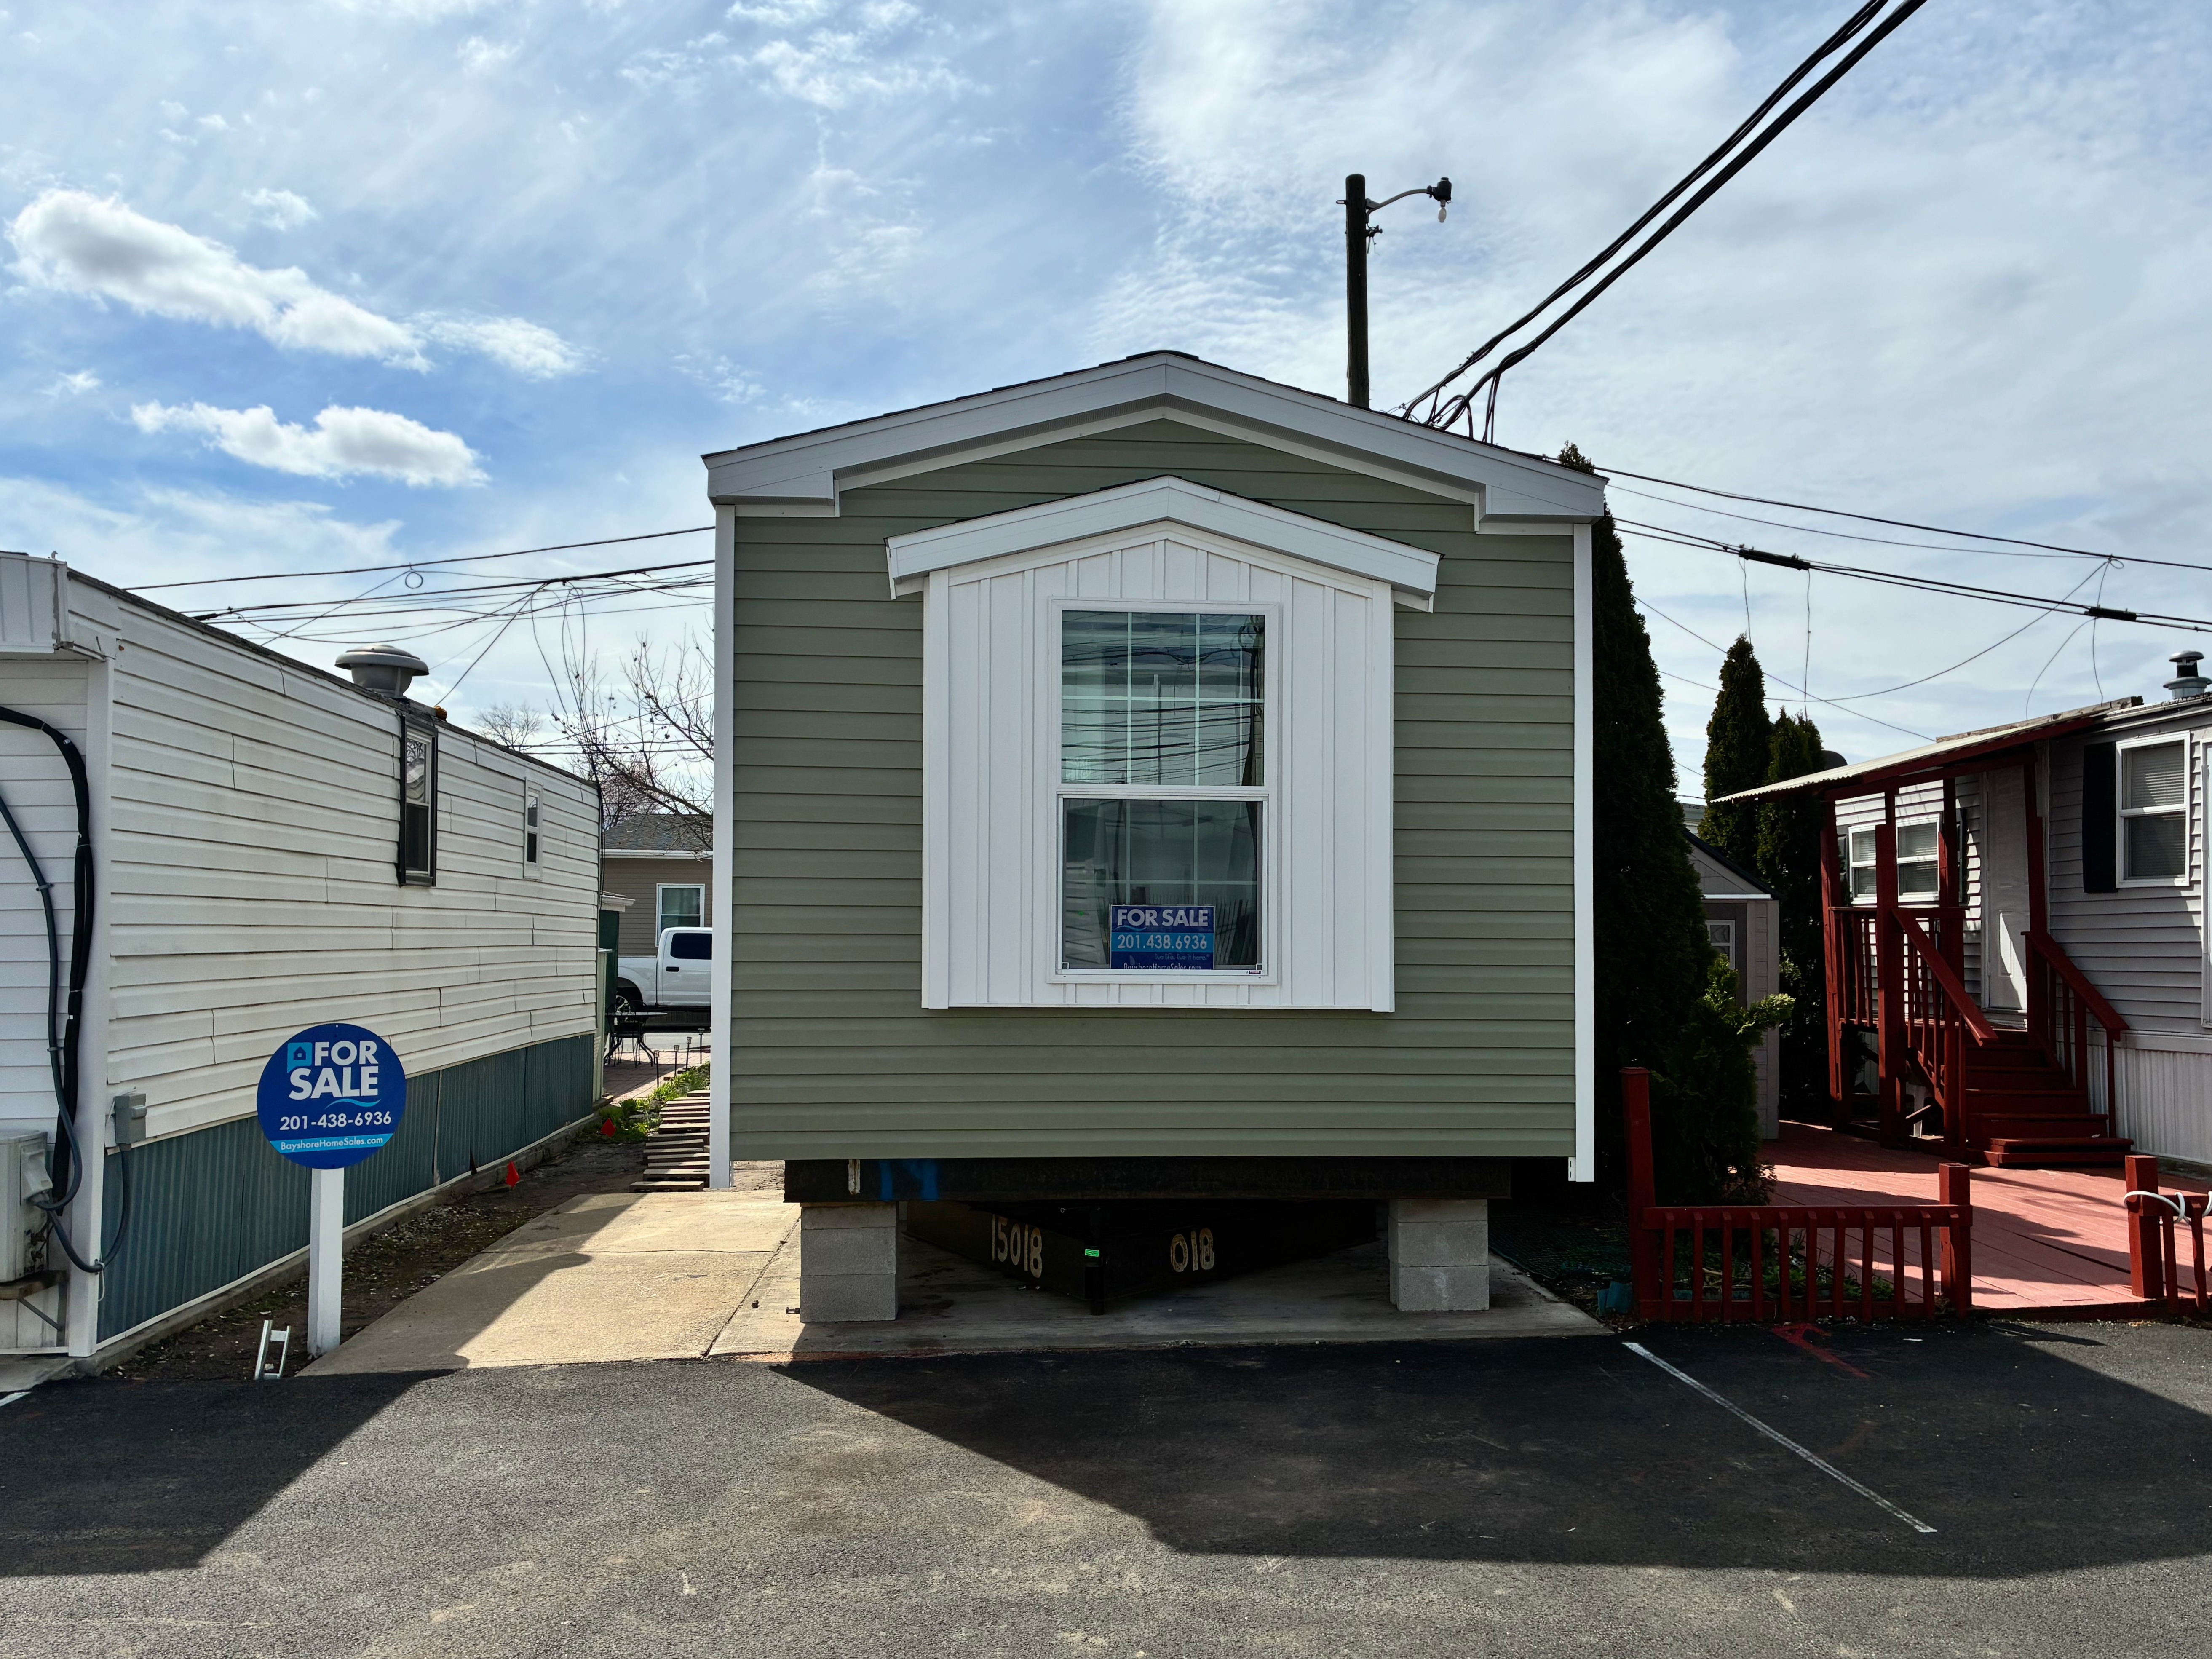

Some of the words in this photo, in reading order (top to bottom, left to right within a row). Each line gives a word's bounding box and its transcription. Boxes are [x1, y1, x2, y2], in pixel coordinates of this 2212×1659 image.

[1117, 908, 1158, 926] FOR
[1162, 909, 1208, 926] SALE
[1118, 934, 1207, 949] 201.438.6936
[315, 1041, 379, 1066] FOR
[289, 1066, 379, 1100] SALE
[279, 1111, 392, 1130] 201-438-6936
[281, 1137, 383, 1152] BayshoreHomeSales.com
[992, 1214, 1042, 1278] 15018
[1170, 1228, 1214, 1272] 018
